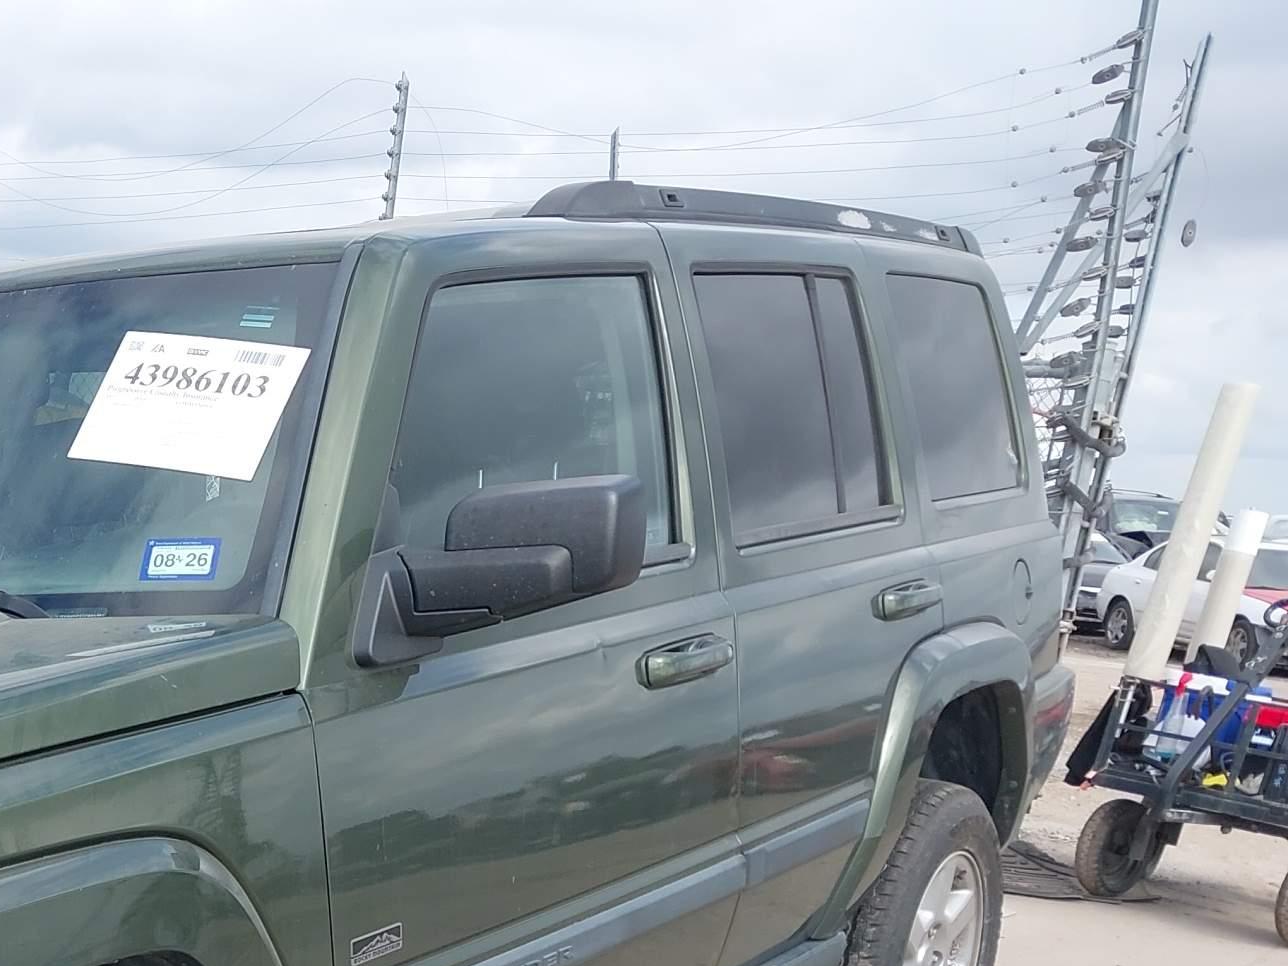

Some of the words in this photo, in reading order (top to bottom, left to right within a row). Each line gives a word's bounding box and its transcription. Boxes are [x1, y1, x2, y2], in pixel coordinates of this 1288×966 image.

[124, 362, 270, 399] 43986103
[153, 553, 175, 567] 08
[185, 552, 209, 567] 26
